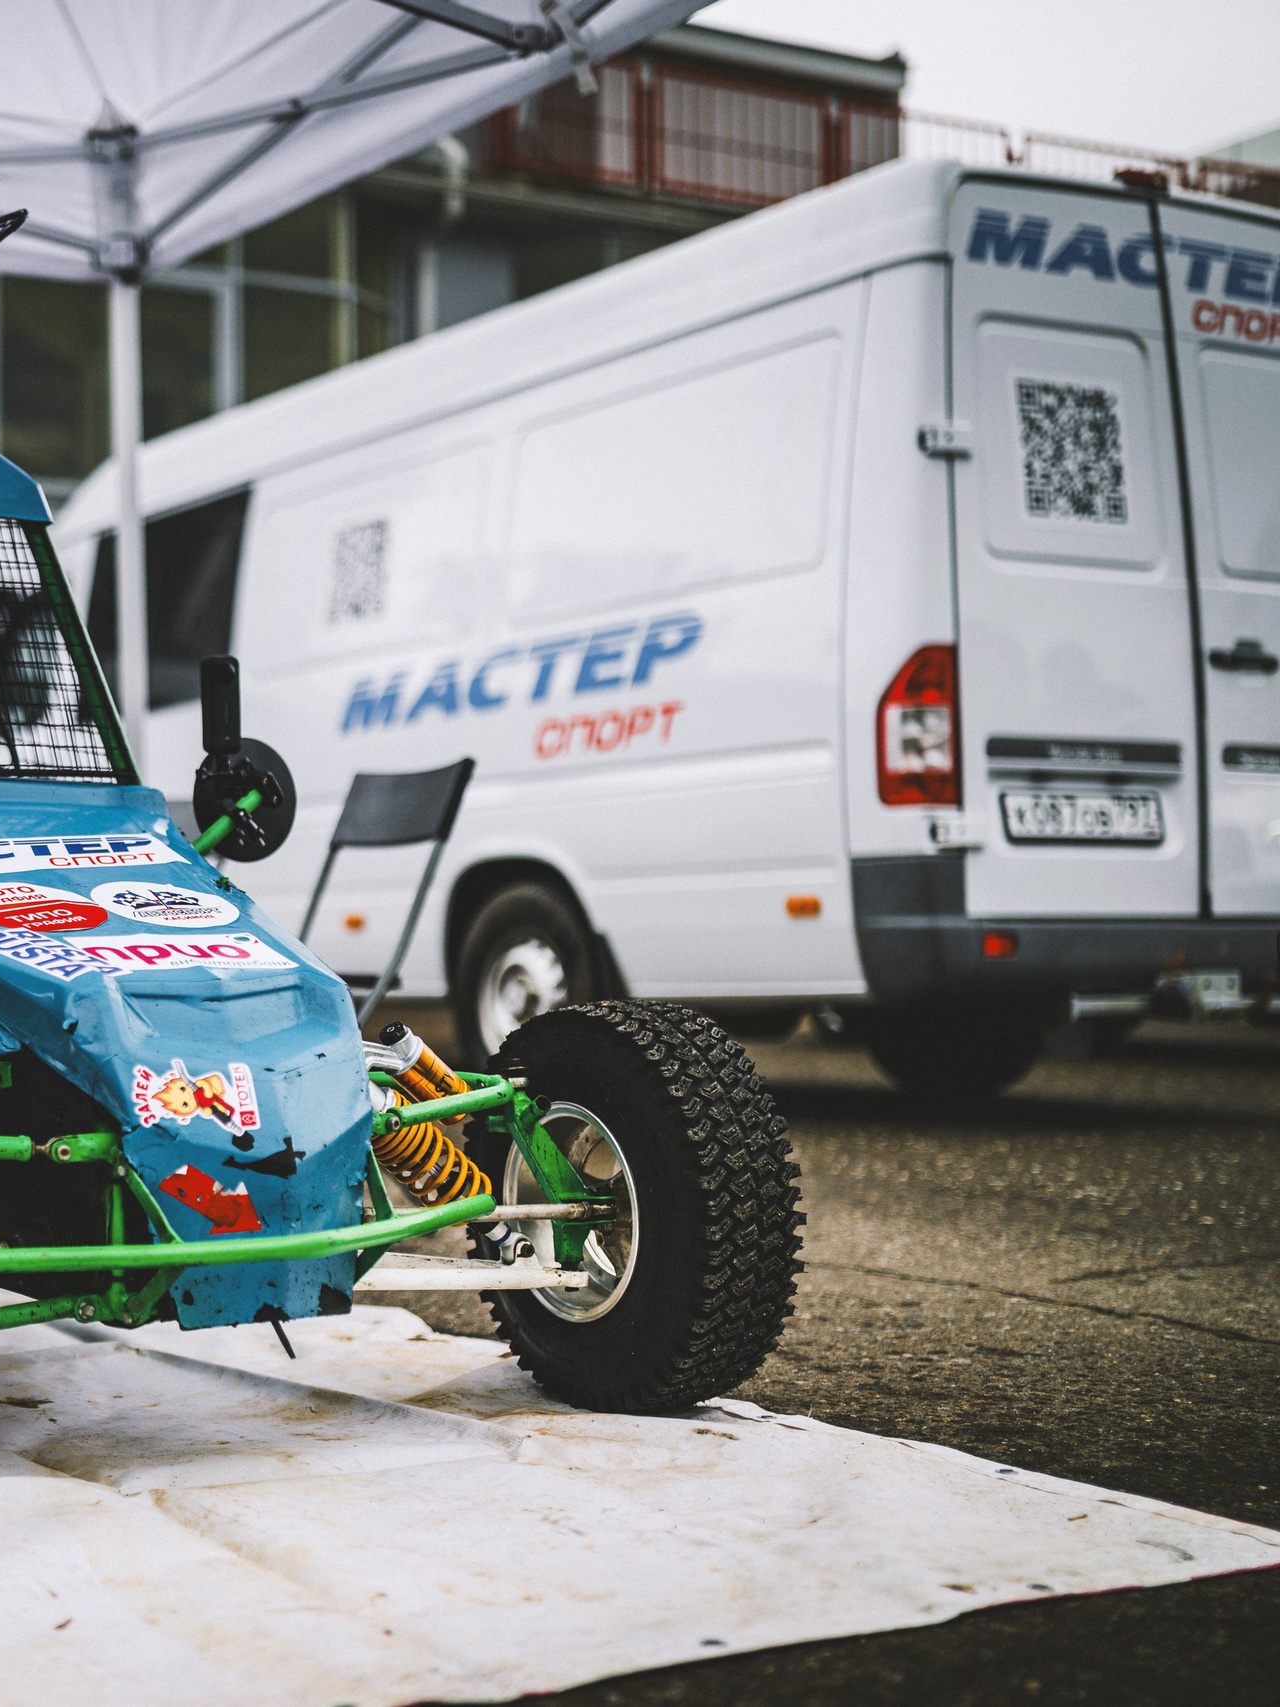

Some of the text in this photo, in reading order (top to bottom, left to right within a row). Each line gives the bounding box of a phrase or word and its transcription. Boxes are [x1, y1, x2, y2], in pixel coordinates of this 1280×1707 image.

[966, 206, 1280, 309] МАСТЕ
[341, 609, 704, 734] МАСТЕР
[49, 852, 156, 867] СПОРТ
[4, 908, 74, 923] ТИПО
[22, 915, 87, 929] ГРАФИЯ
[135, 1068, 157, 1124] ЗАЛЕЙ
